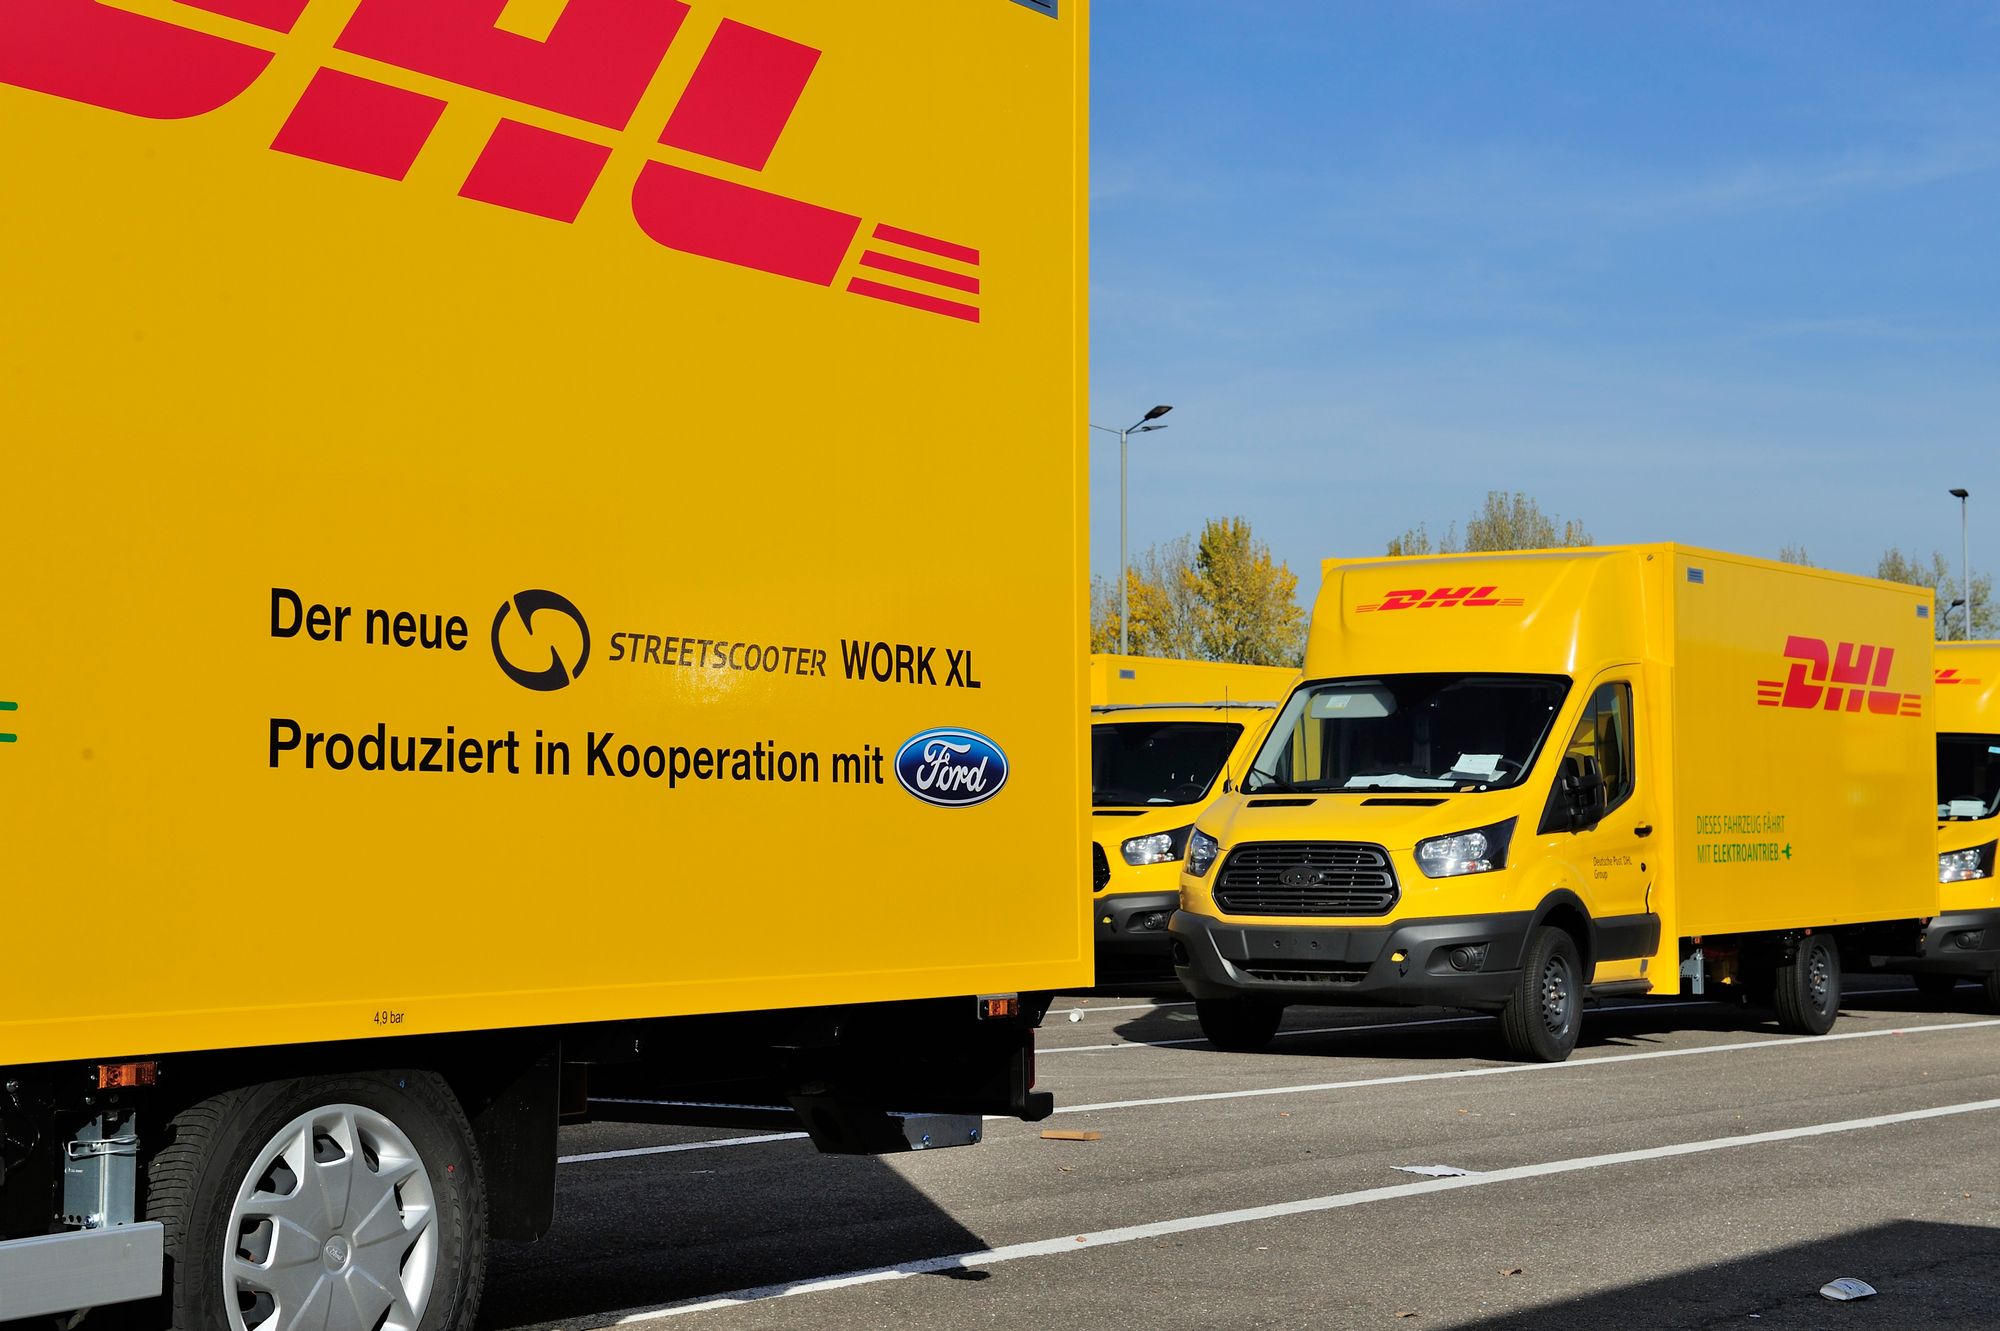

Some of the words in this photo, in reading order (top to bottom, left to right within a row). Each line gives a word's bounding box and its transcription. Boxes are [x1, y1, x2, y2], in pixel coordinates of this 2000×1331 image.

[1376, 586, 1500, 611] DHL
[270, 587, 352, 642] Der
[365, 608, 468, 652] neue
[609, 632, 827, 677] STREETSCOOTER
[841, 639, 937, 686] WORK
[945, 648, 981, 689] XL
[1781, 635, 1902, 715] DHL
[269, 717, 520, 775] Produziert
[535, 729, 570, 776] in
[587, 731, 819, 789] Kooperation
[832, 744, 884, 785] mit
[916, 739, 988, 792] Ford
[1696, 815, 1722, 835] DIESES
[1723, 815, 1761, 834] FAHRZEUG
[1593, 856, 1612, 867] Deutsche
[1613, 855, 1623, 866] Post
[1623, 855, 1632, 865] DHL
[1697, 844, 1712, 863] MIT
[1594, 869, 1608, 880] Group
[374, 1010, 388, 1026] 4,9
[390, 1010, 404, 1024] bar
